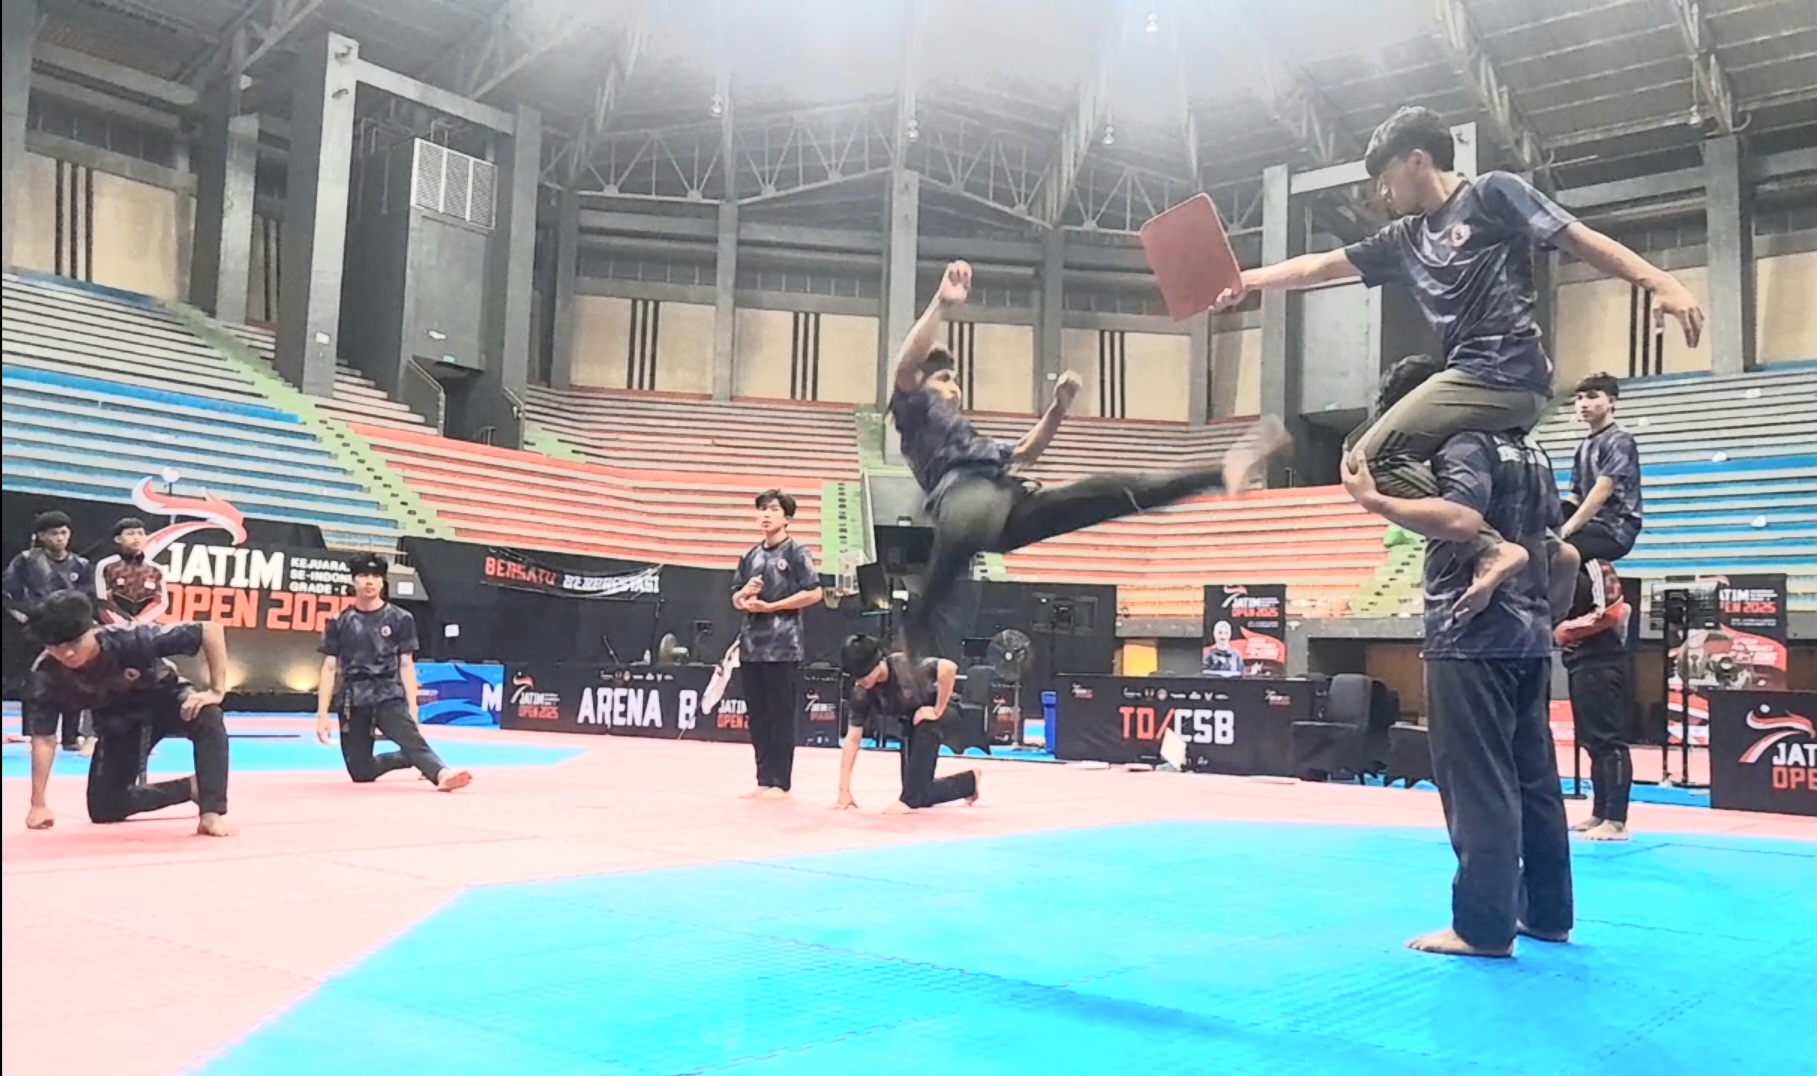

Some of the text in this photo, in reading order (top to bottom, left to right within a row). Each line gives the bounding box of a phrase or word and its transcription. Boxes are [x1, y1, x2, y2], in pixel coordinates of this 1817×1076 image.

[165, 542, 284, 590] JATIM
[291, 557, 351, 573] KEJUARA
[485, 556, 660, 594] BERSATU BERPRASI
[289, 581, 332, 595] GRADE
[154, 584, 356, 632] OPEN 202
[518, 692, 545, 706] JATIM
[577, 687, 698, 729] ARENA B
[717, 713, 743, 729] OPEN
[1772, 742, 1817, 767] JAT
[1772, 766, 1817, 791] OPE
